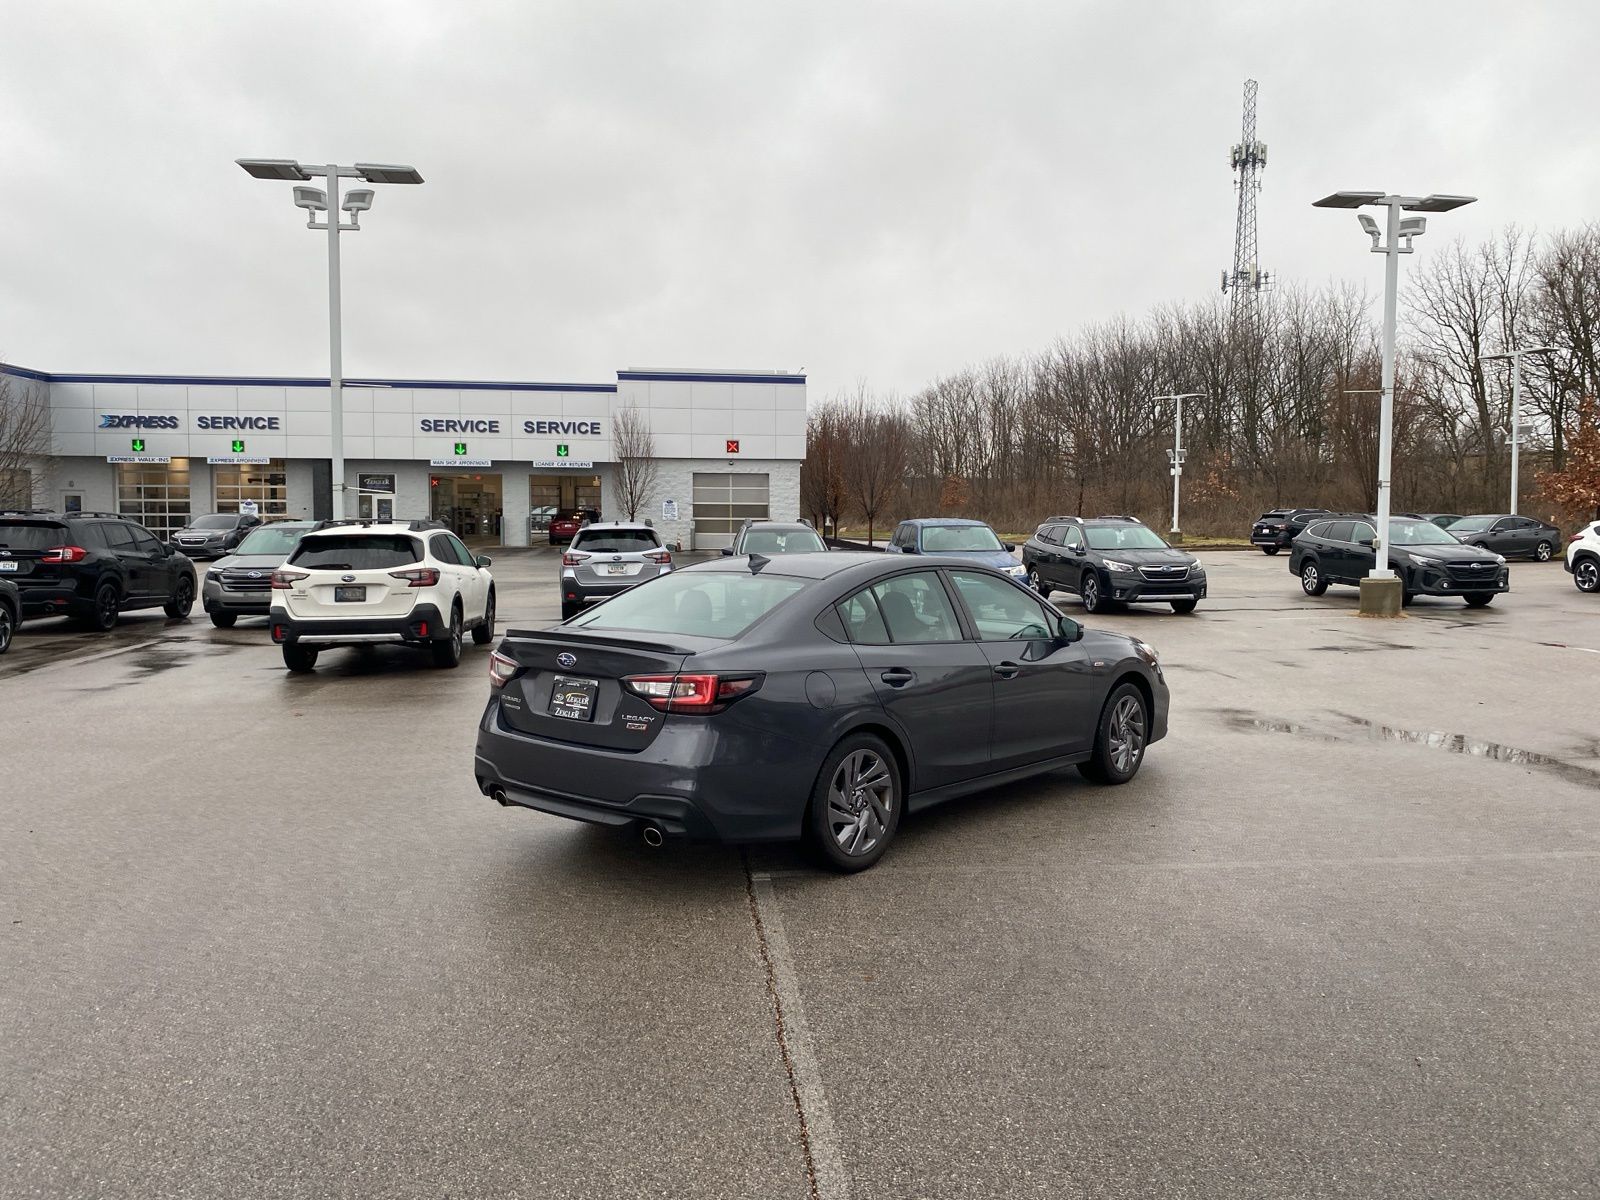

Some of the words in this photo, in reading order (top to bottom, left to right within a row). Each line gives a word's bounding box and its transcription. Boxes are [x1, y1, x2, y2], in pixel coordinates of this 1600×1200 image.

[99, 415, 179, 429] EXPRESS
[197, 416, 280, 430] SERVICE
[420, 419, 500, 433] SERVICE
[523, 421, 601, 435] SERVICE
[565, 692, 589, 705] ZEIGLER
[554, 707, 580, 719] ZEIGLER
[621, 714, 655, 722] LEGACY
